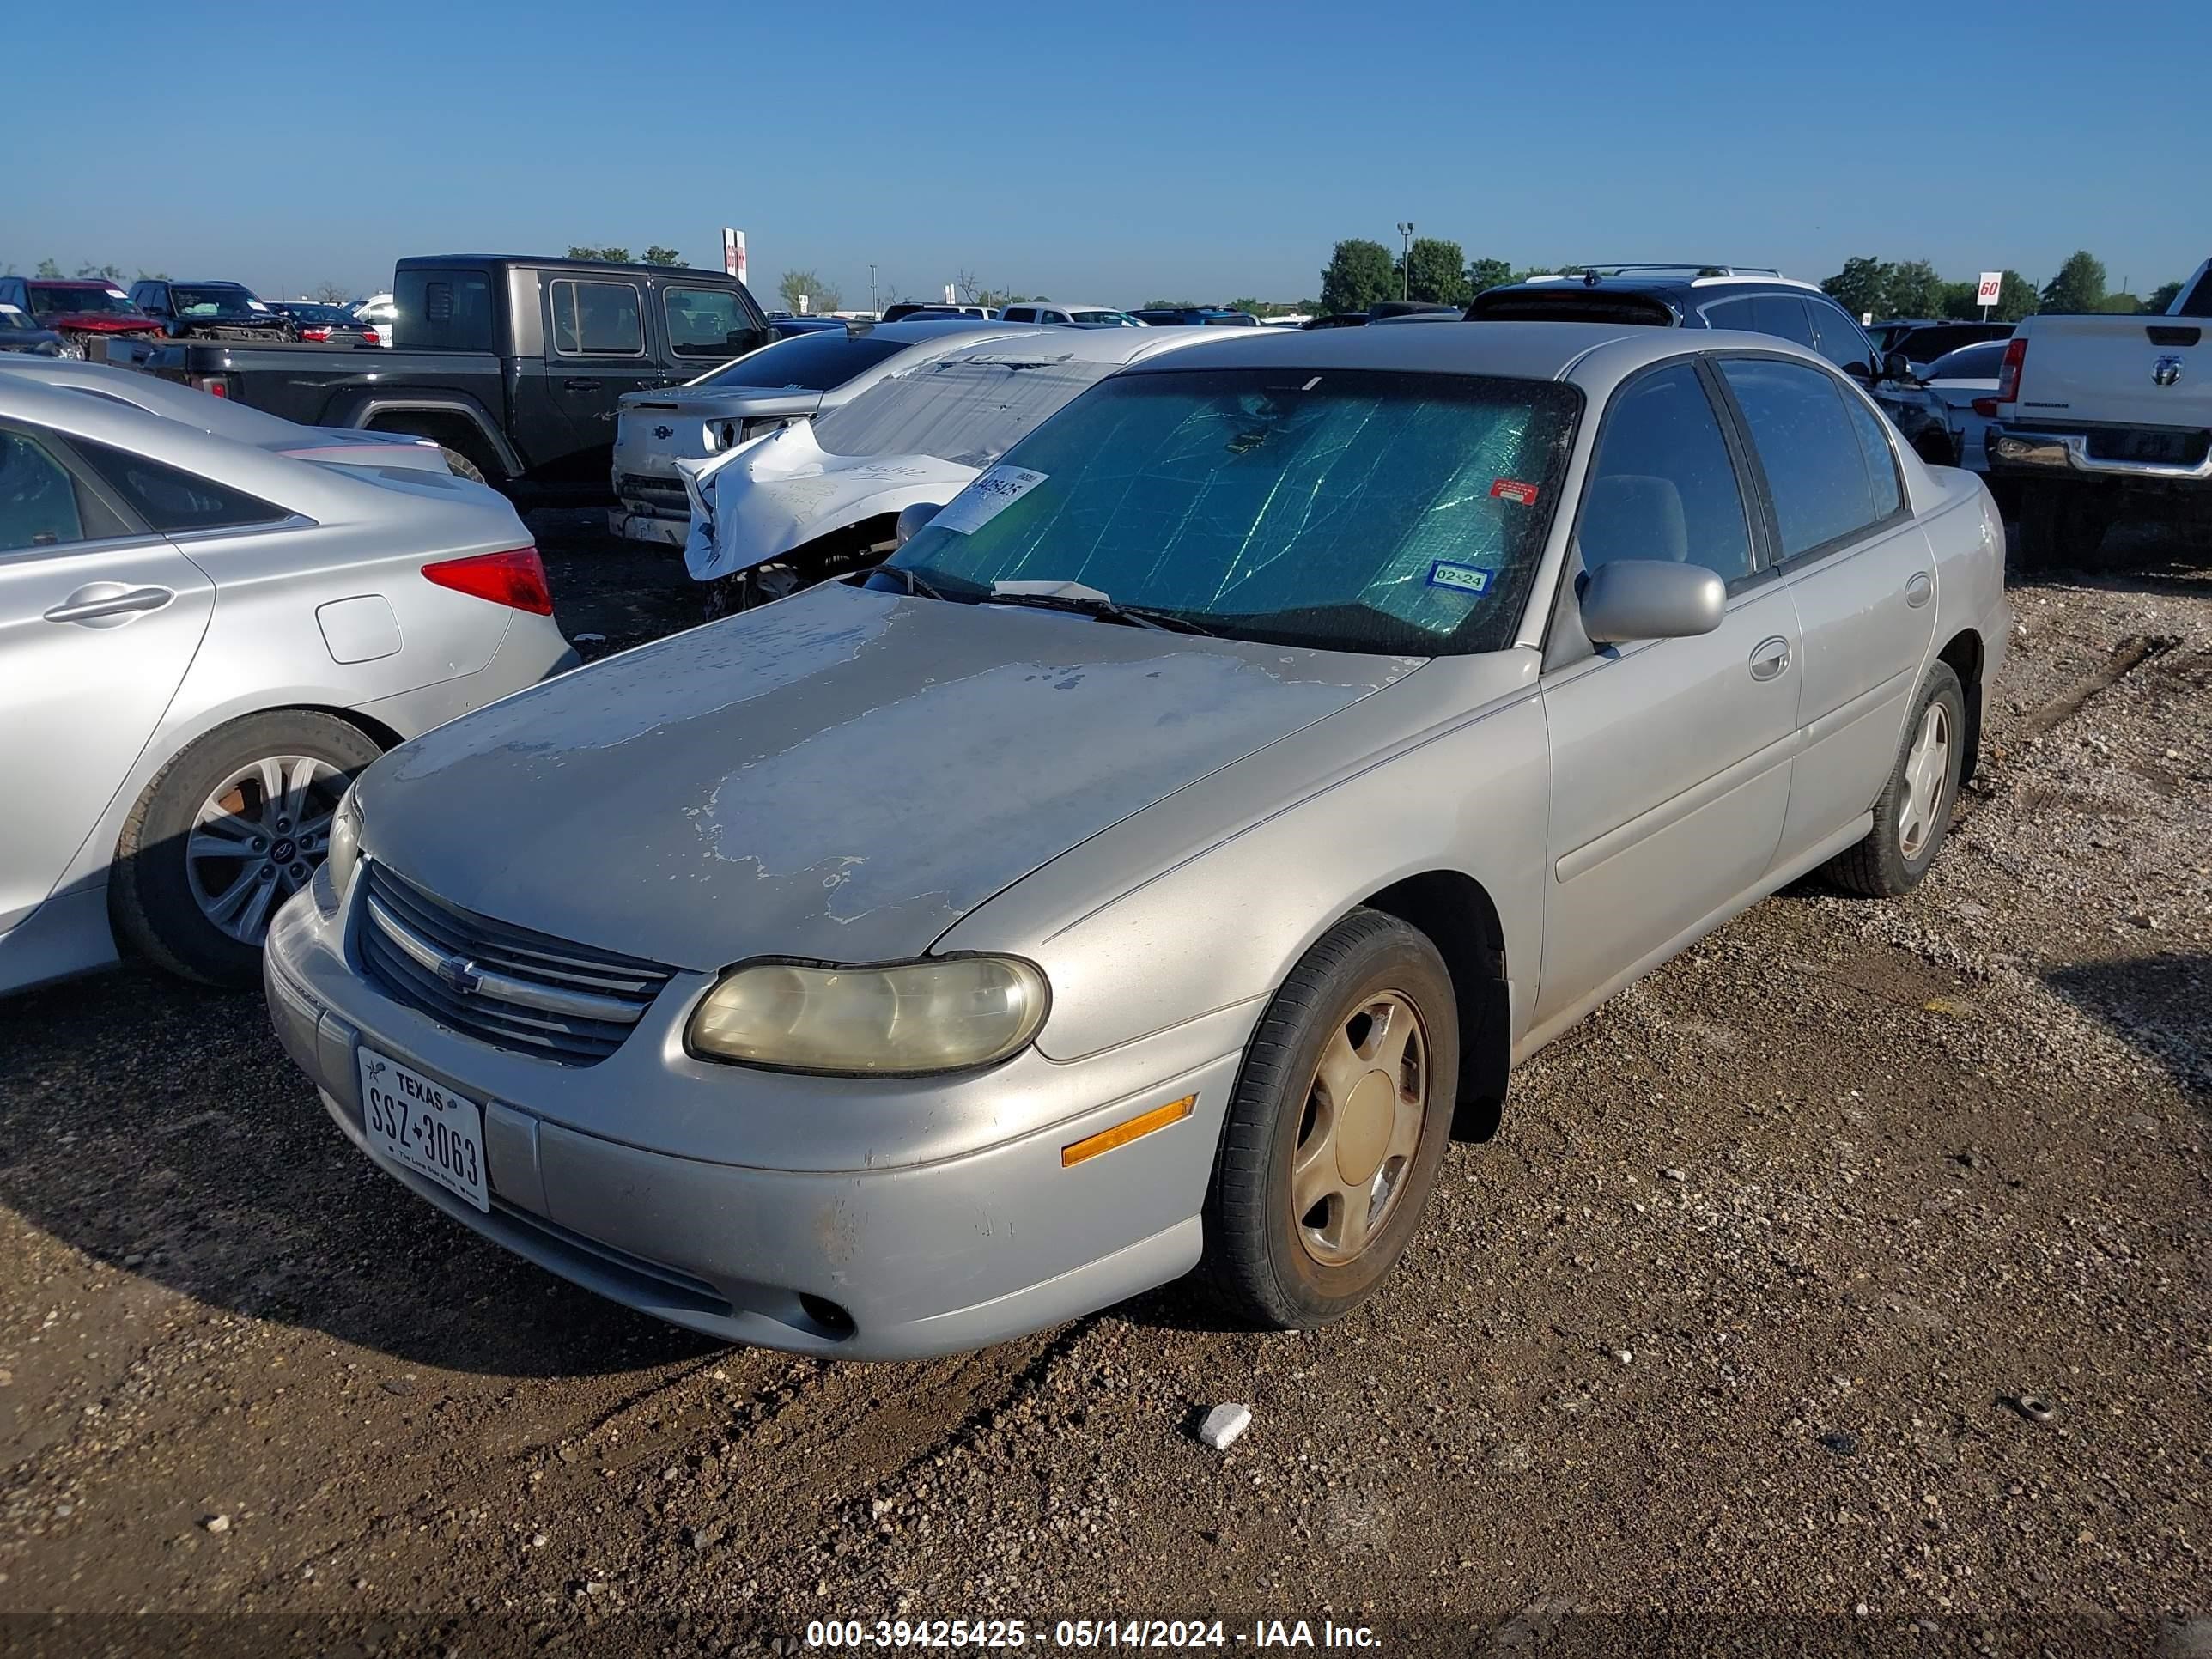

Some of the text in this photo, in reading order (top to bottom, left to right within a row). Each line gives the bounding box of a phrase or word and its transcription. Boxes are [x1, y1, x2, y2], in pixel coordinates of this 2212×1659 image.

[1980, 282, 1998, 295] 60
[396, 1071, 443, 1111] TEXAS
[423, 1115, 478, 1187] 3063
